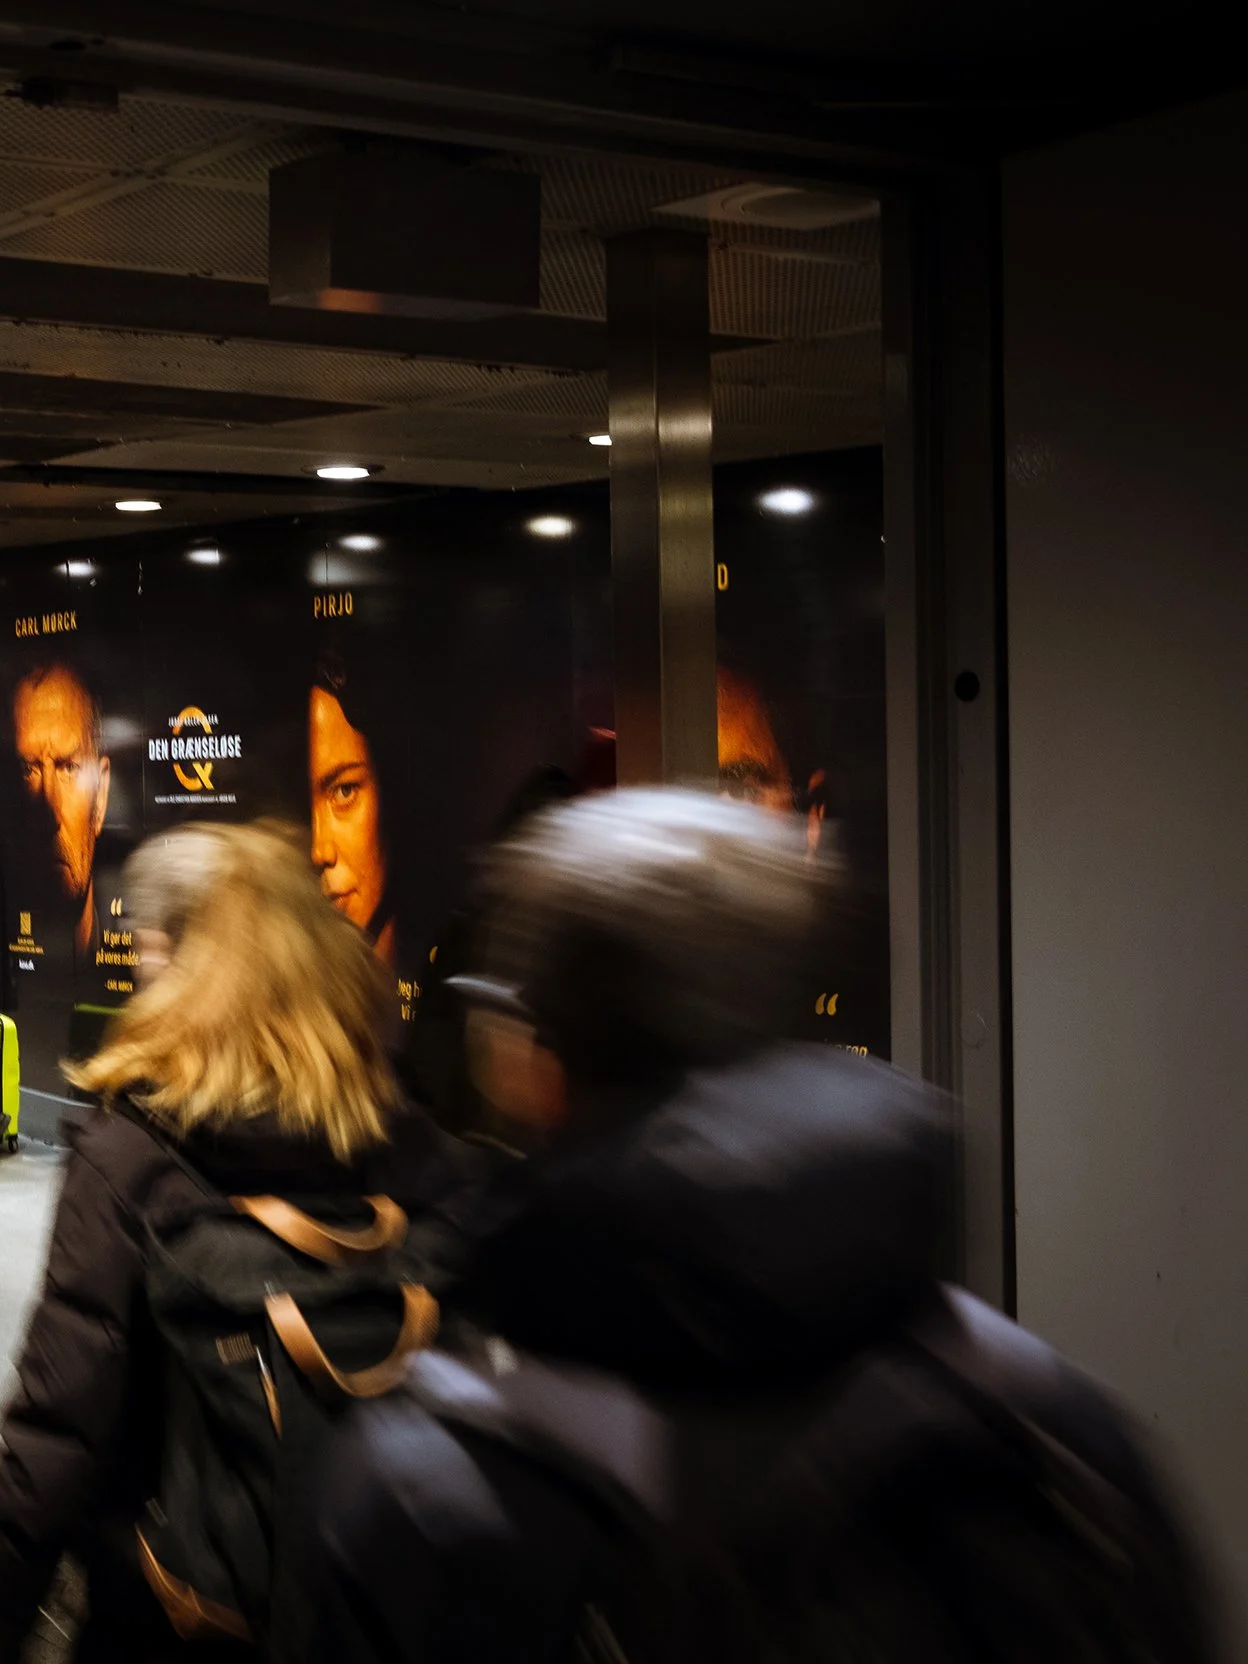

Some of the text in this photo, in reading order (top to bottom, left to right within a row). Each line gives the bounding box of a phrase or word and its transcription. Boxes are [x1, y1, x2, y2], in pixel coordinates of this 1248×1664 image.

[717, 563, 728, 591] D
[313, 591, 354, 619] PIRJO
[15, 610, 78, 638] CARL MØRCK
[148, 734, 242, 761] DEN GRÆNSELØSE
[104, 951, 121, 966] vores
[397, 977, 412, 1000] Jeg
